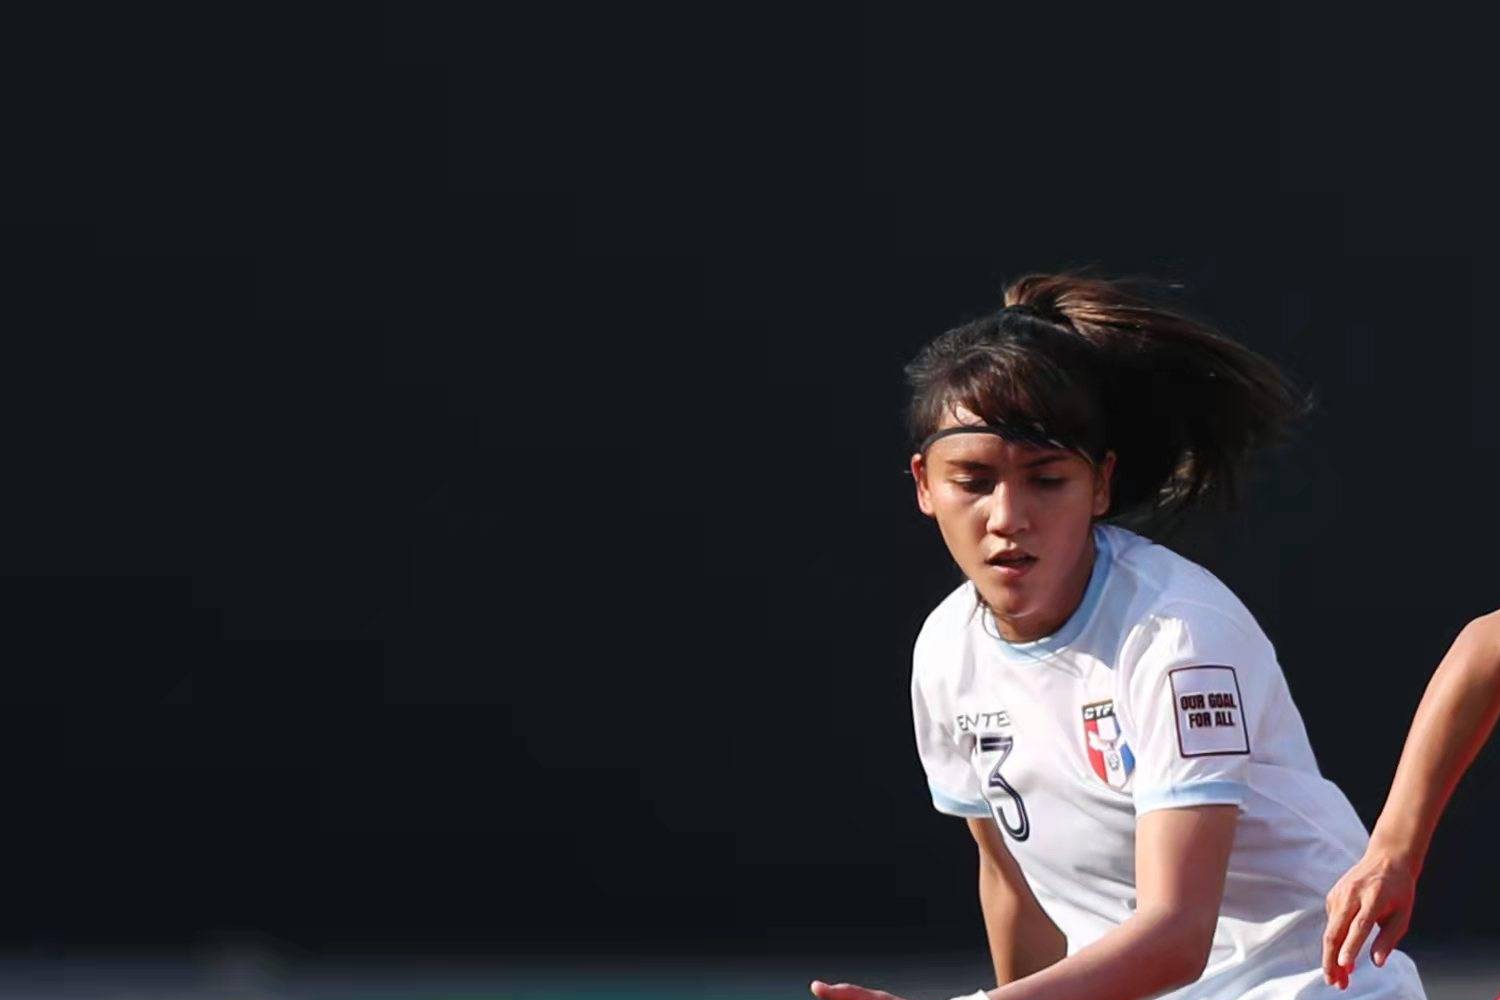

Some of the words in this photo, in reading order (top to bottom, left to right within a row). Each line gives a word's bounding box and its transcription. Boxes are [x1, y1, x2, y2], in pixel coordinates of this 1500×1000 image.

[1180, 694, 1205, 711] OUR
[1208, 693, 1237, 709] GOAL
[1188, 711, 1212, 729] FOR
[1214, 711, 1236, 727] ALL
[979, 736, 1030, 843] 3
